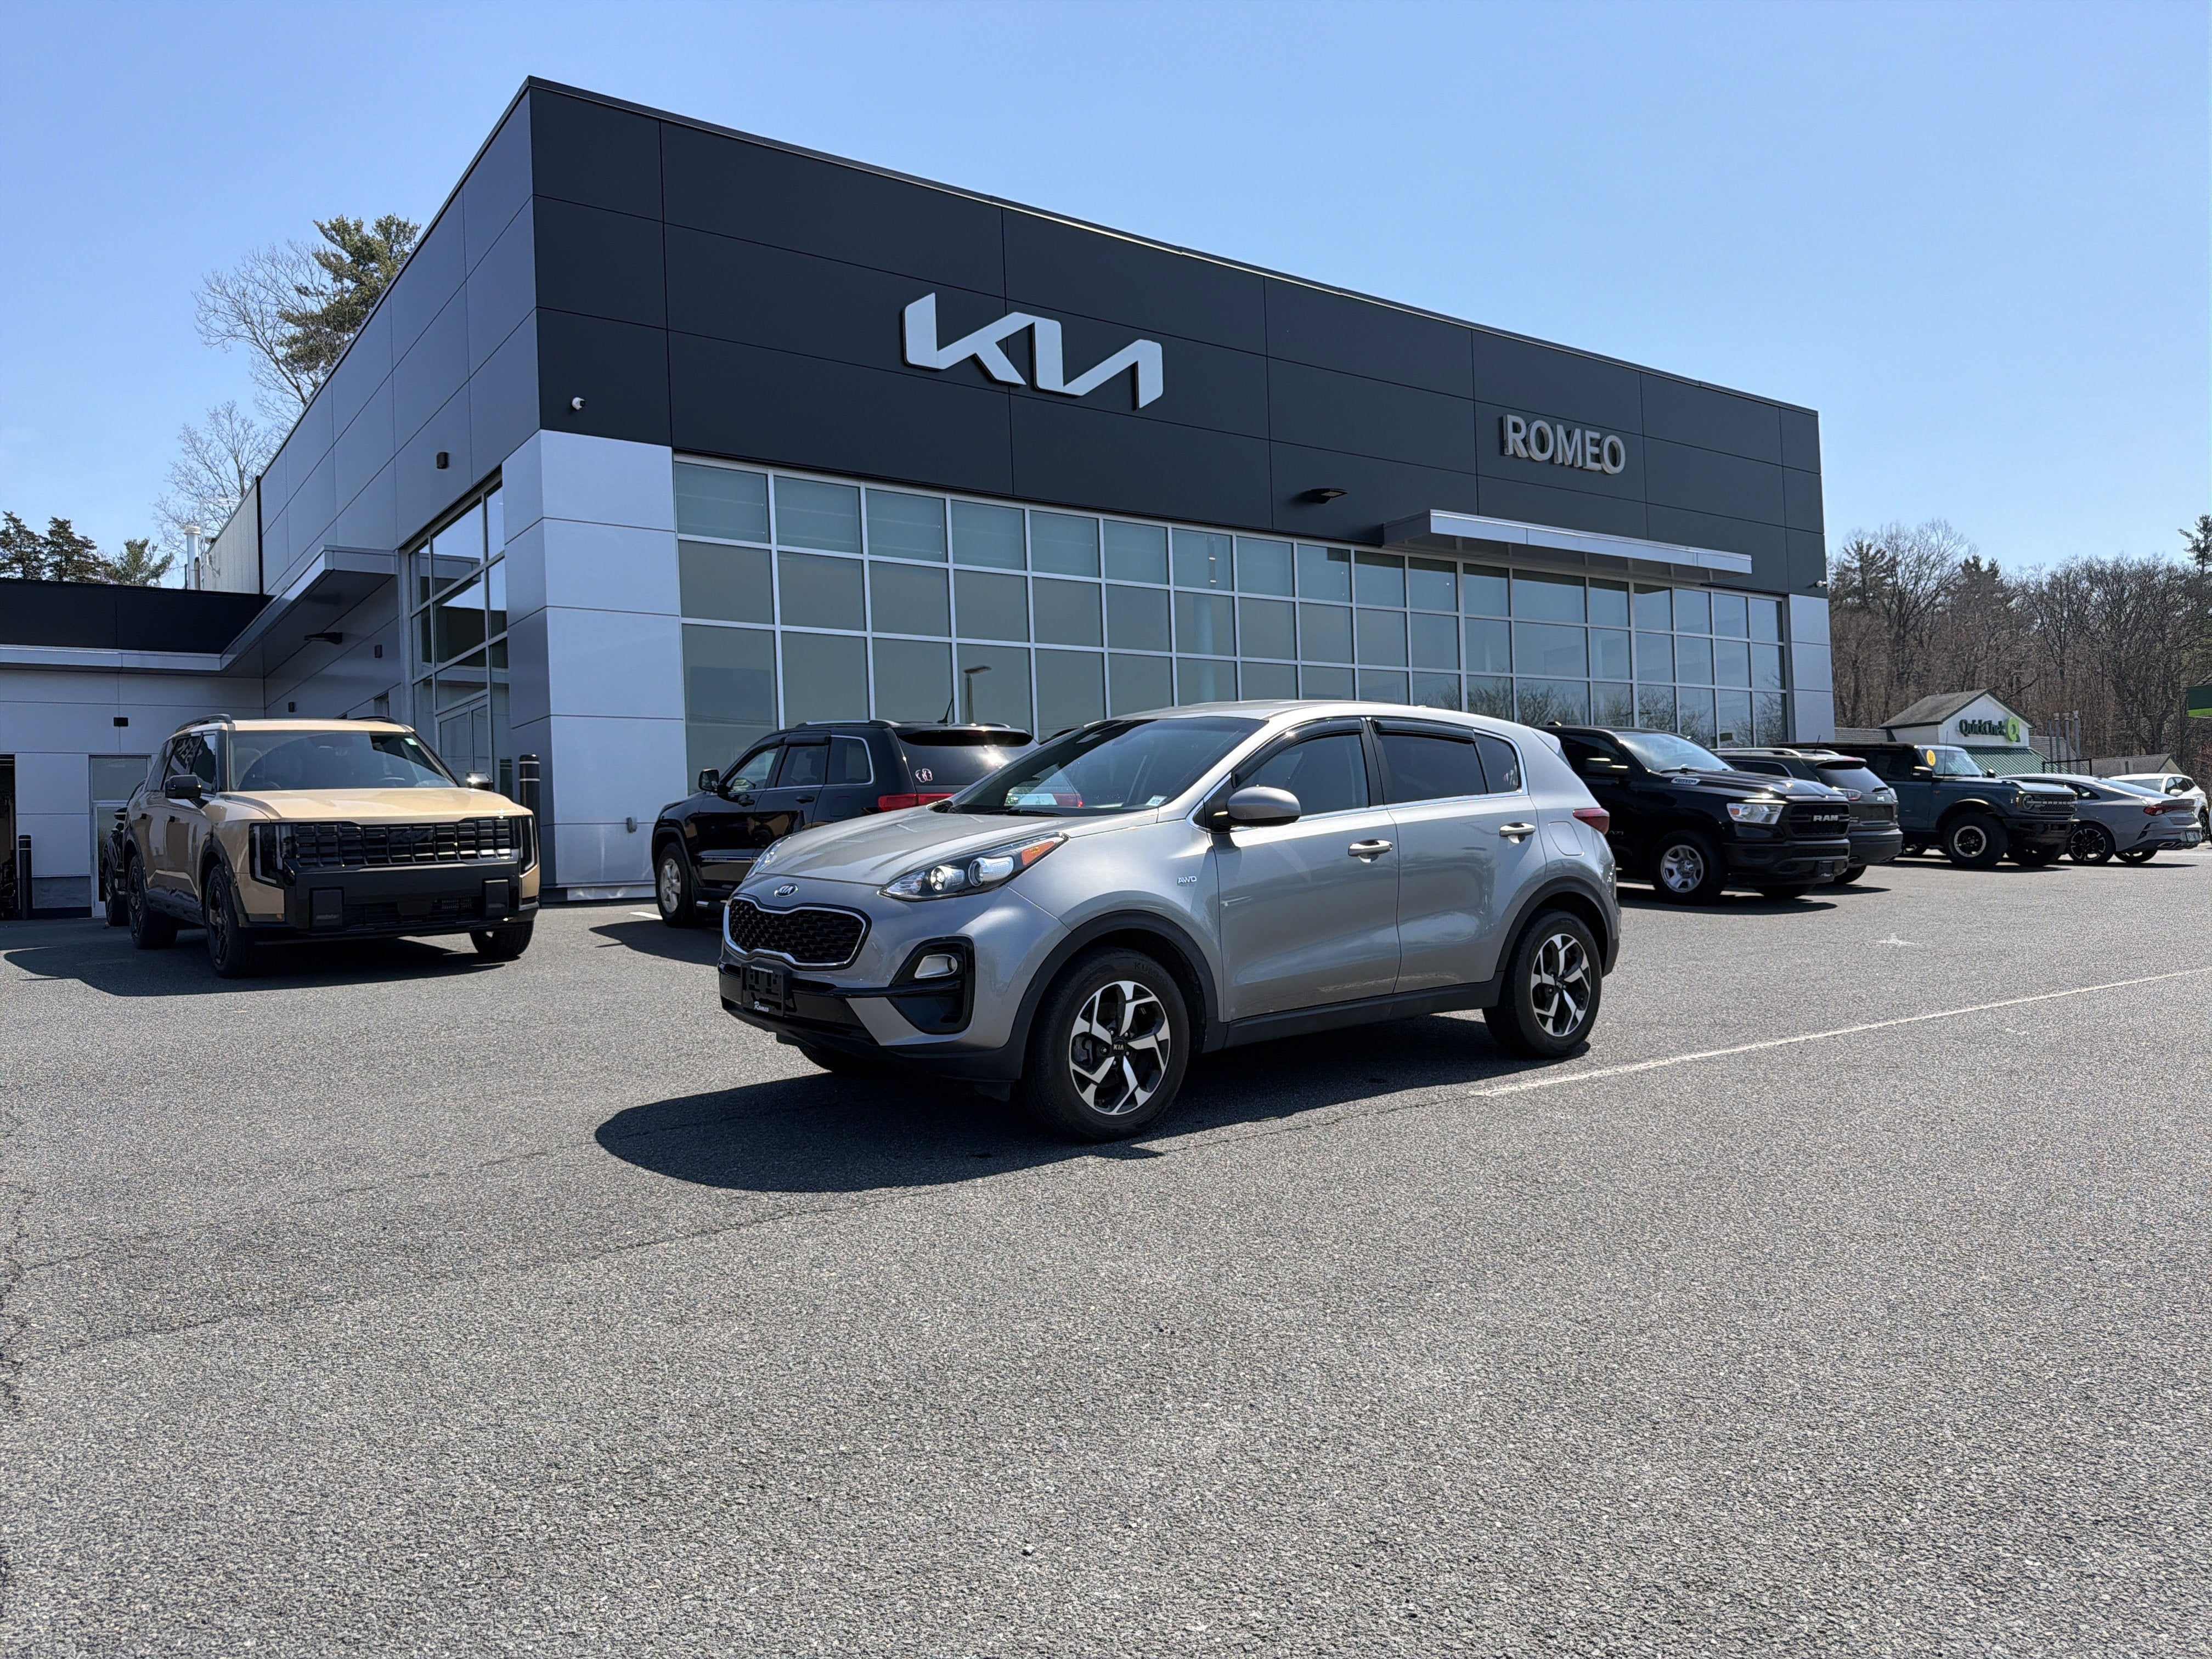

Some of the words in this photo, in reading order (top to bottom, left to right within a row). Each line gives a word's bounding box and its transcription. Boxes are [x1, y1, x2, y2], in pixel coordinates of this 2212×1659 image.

[904, 292, 1164, 409] KIA
[1502, 414, 1626, 475] ROMEO
[778, 885, 794, 894] KIA
[1177, 876, 1197, 884] AWD
